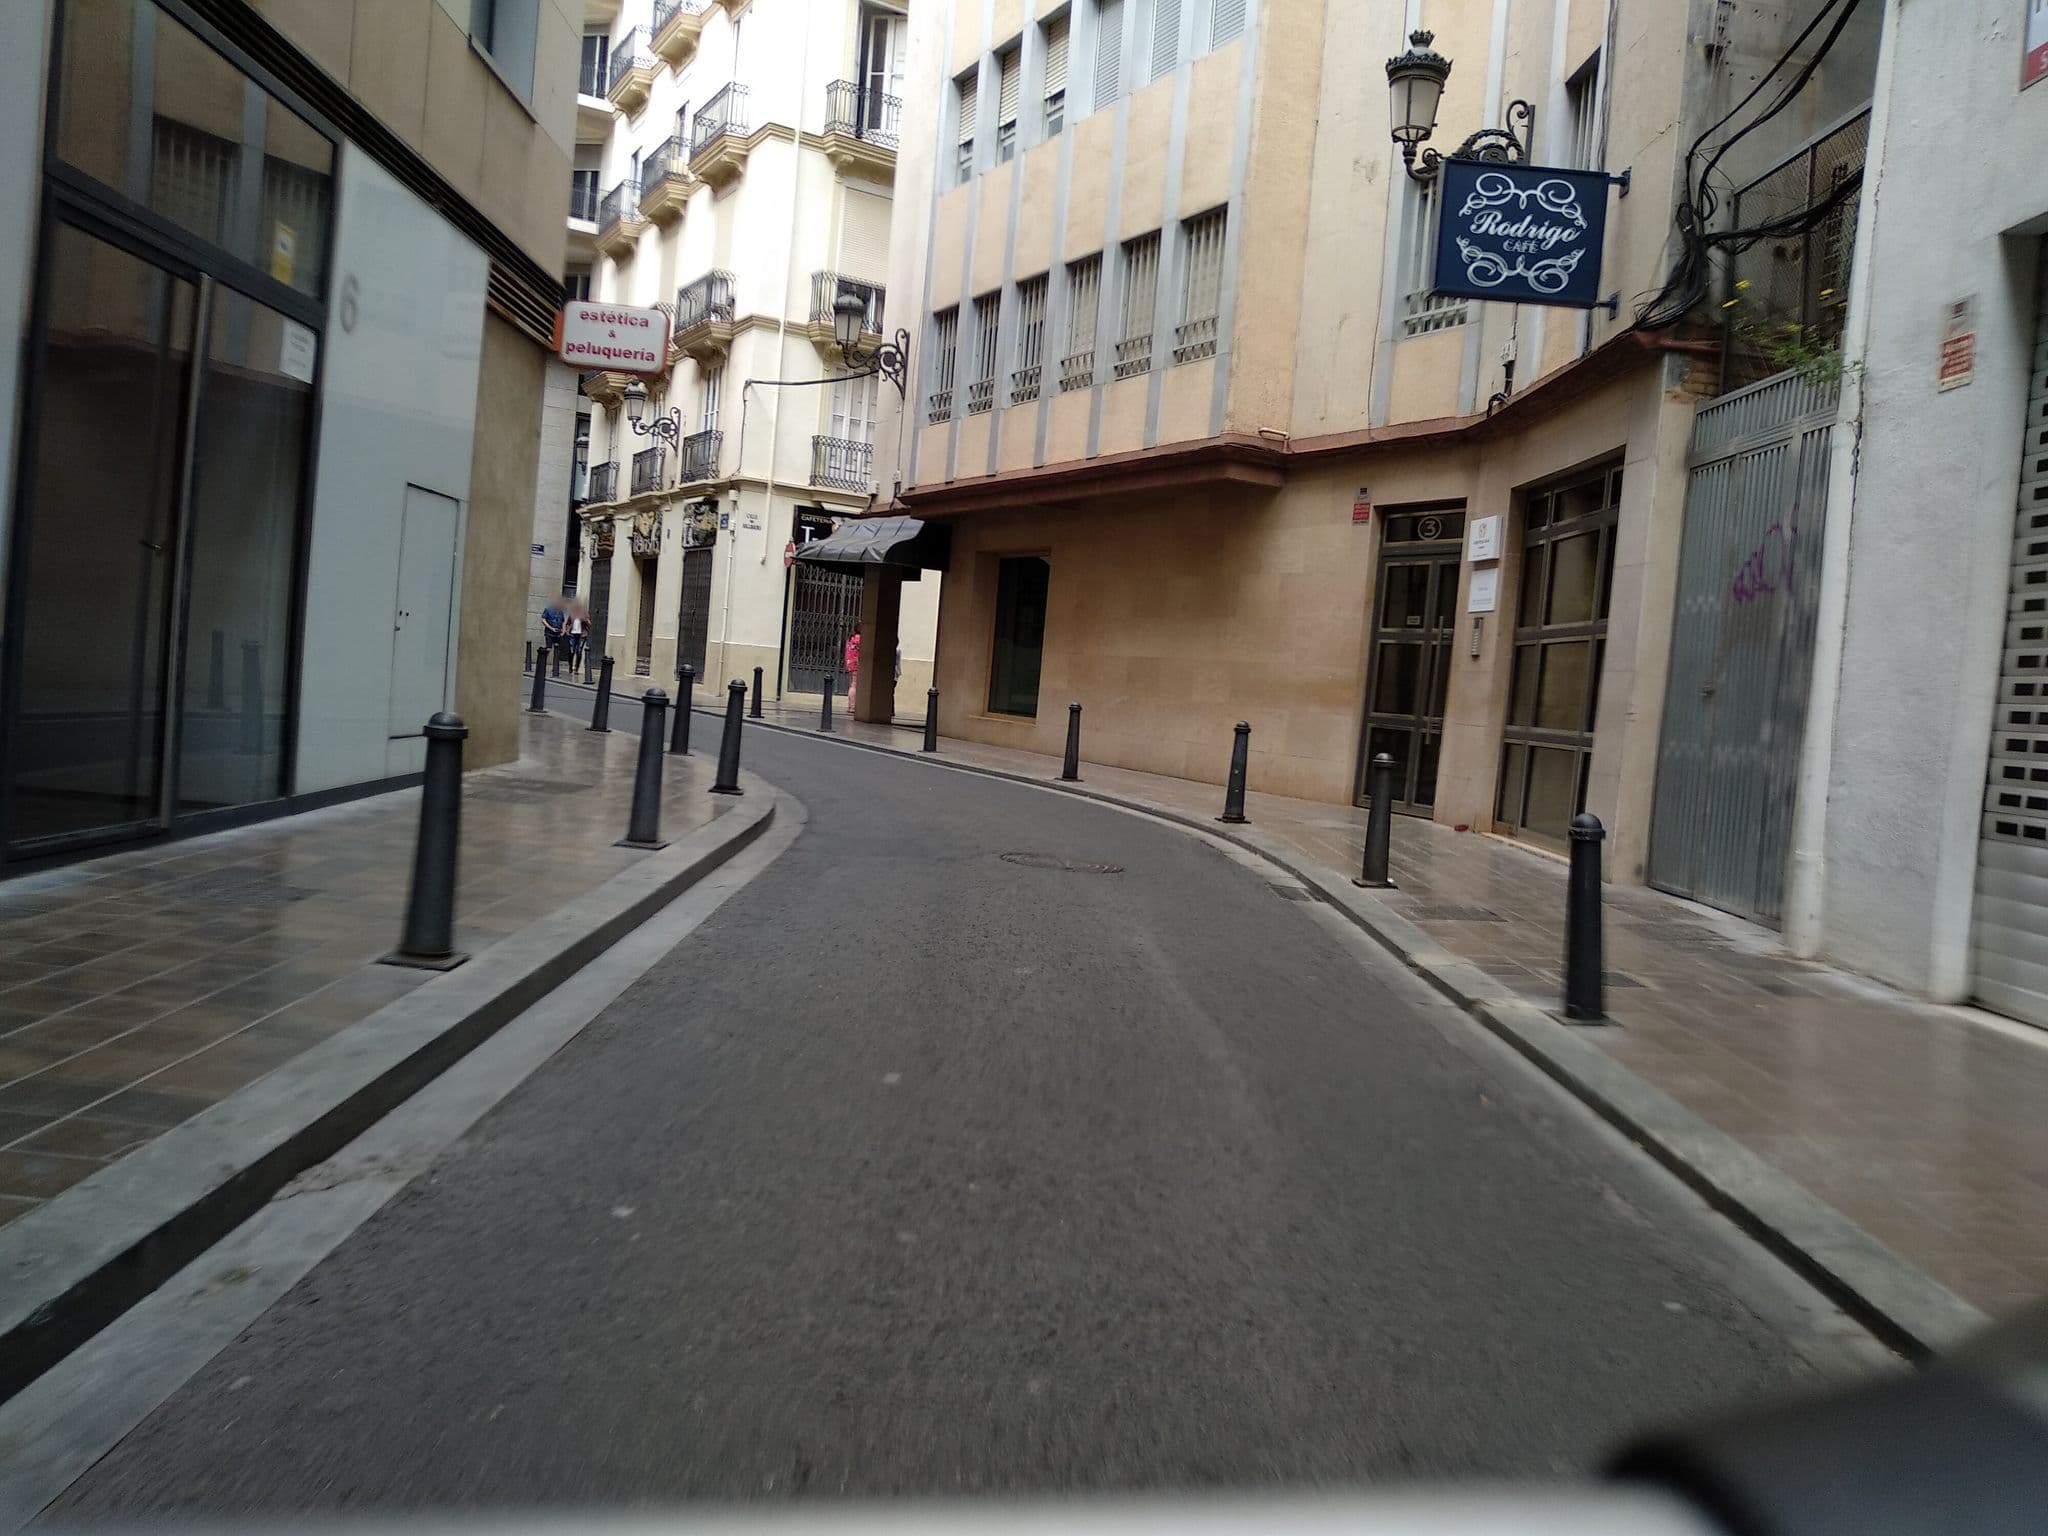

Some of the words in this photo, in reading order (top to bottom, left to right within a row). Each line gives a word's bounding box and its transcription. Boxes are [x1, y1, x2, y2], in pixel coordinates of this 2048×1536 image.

[1470, 210, 1581, 250] Rodrigo
[1503, 239, 1540, 254] CAFÉ
[340, 273, 360, 335] 6
[580, 310, 649, 328] estética
[608, 329, 616, 339] &
[1424, 520, 1436, 536] 3
